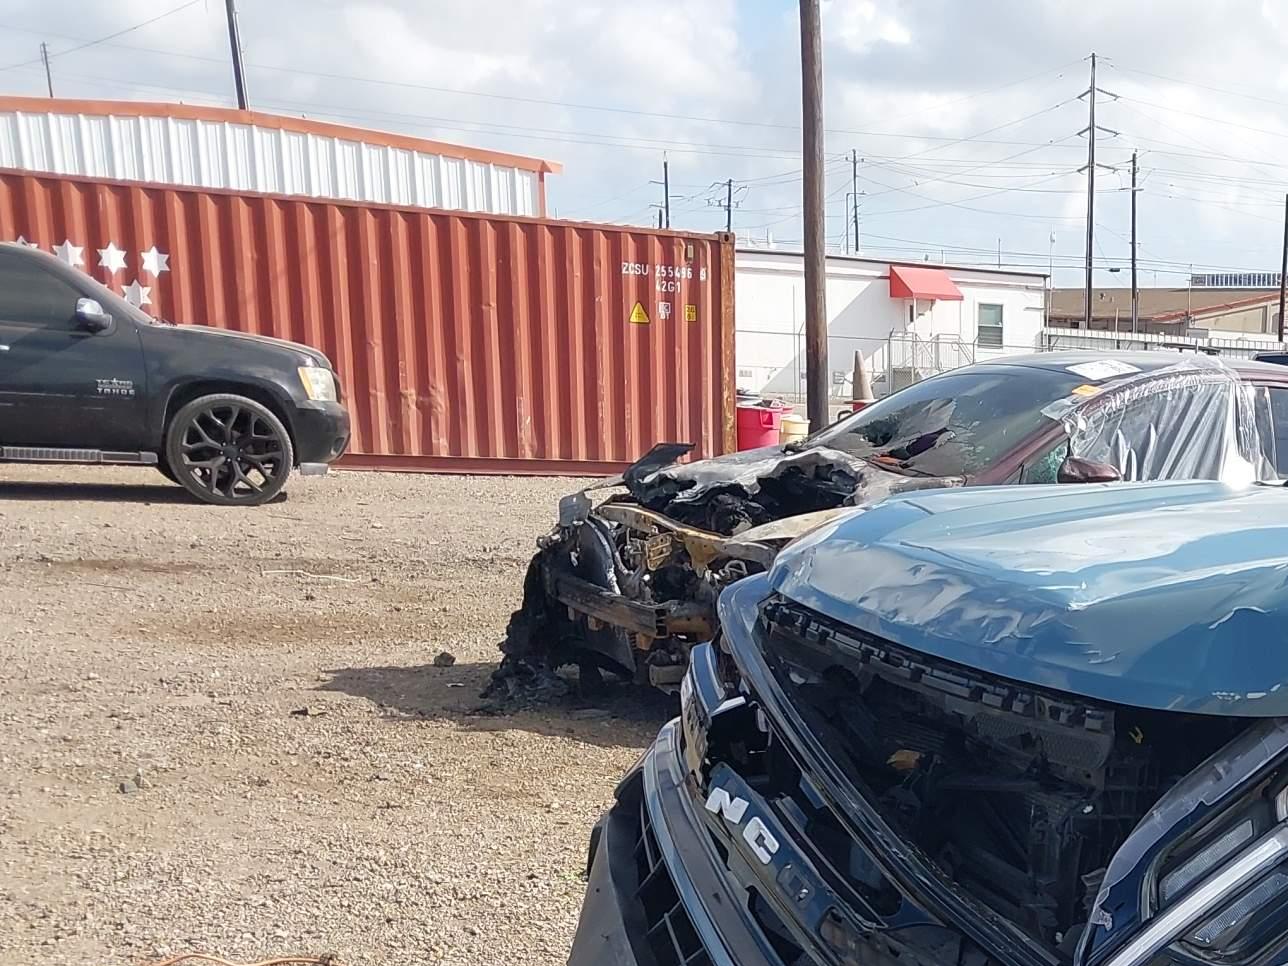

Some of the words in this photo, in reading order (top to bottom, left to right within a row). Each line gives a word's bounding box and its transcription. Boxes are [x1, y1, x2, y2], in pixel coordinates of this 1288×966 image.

[622, 262, 649, 276] ZCSU
[655, 265, 693, 279] 255496
[700, 267, 706, 281] 9
